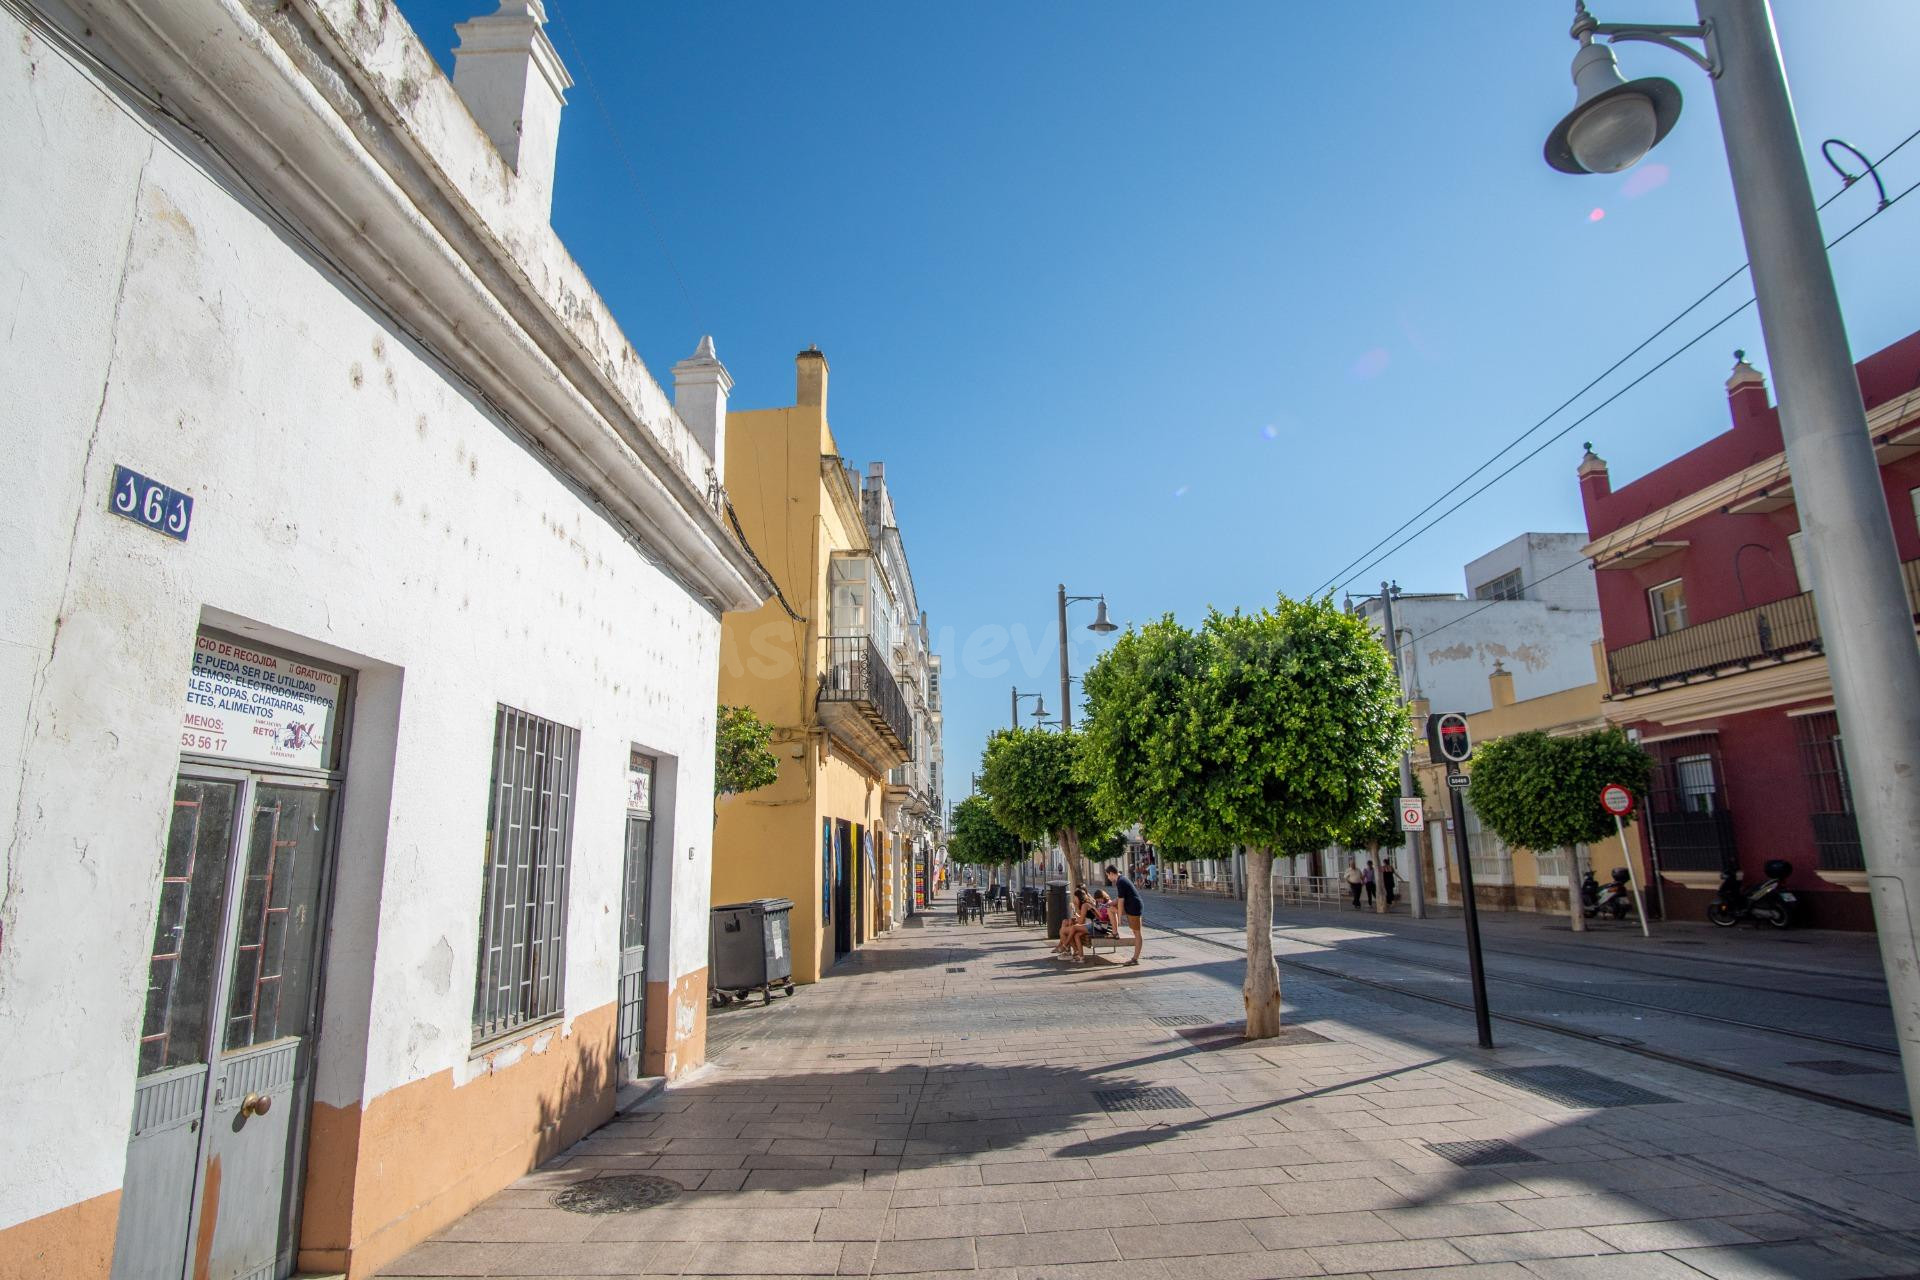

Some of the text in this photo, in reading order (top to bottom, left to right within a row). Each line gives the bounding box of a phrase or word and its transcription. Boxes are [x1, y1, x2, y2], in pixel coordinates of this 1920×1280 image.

[205, 655, 240, 674] PUEDA
[241, 665, 261, 679] SER
[262, 670, 276, 683] DE
[278, 674, 316, 693] UTILIDAD
[218, 643, 232, 656] DE
[233, 647, 277, 669] RECOJIDA
[295, 665, 333, 684] GRATUITO
[235, 675, 335, 710] ELECTRODOMESTICOS,
[251, 693, 305, 716] CHATARRAS,
[218, 698, 274, 719] ALIMENTOS
[181, 733, 228, 752] 53 56 17
